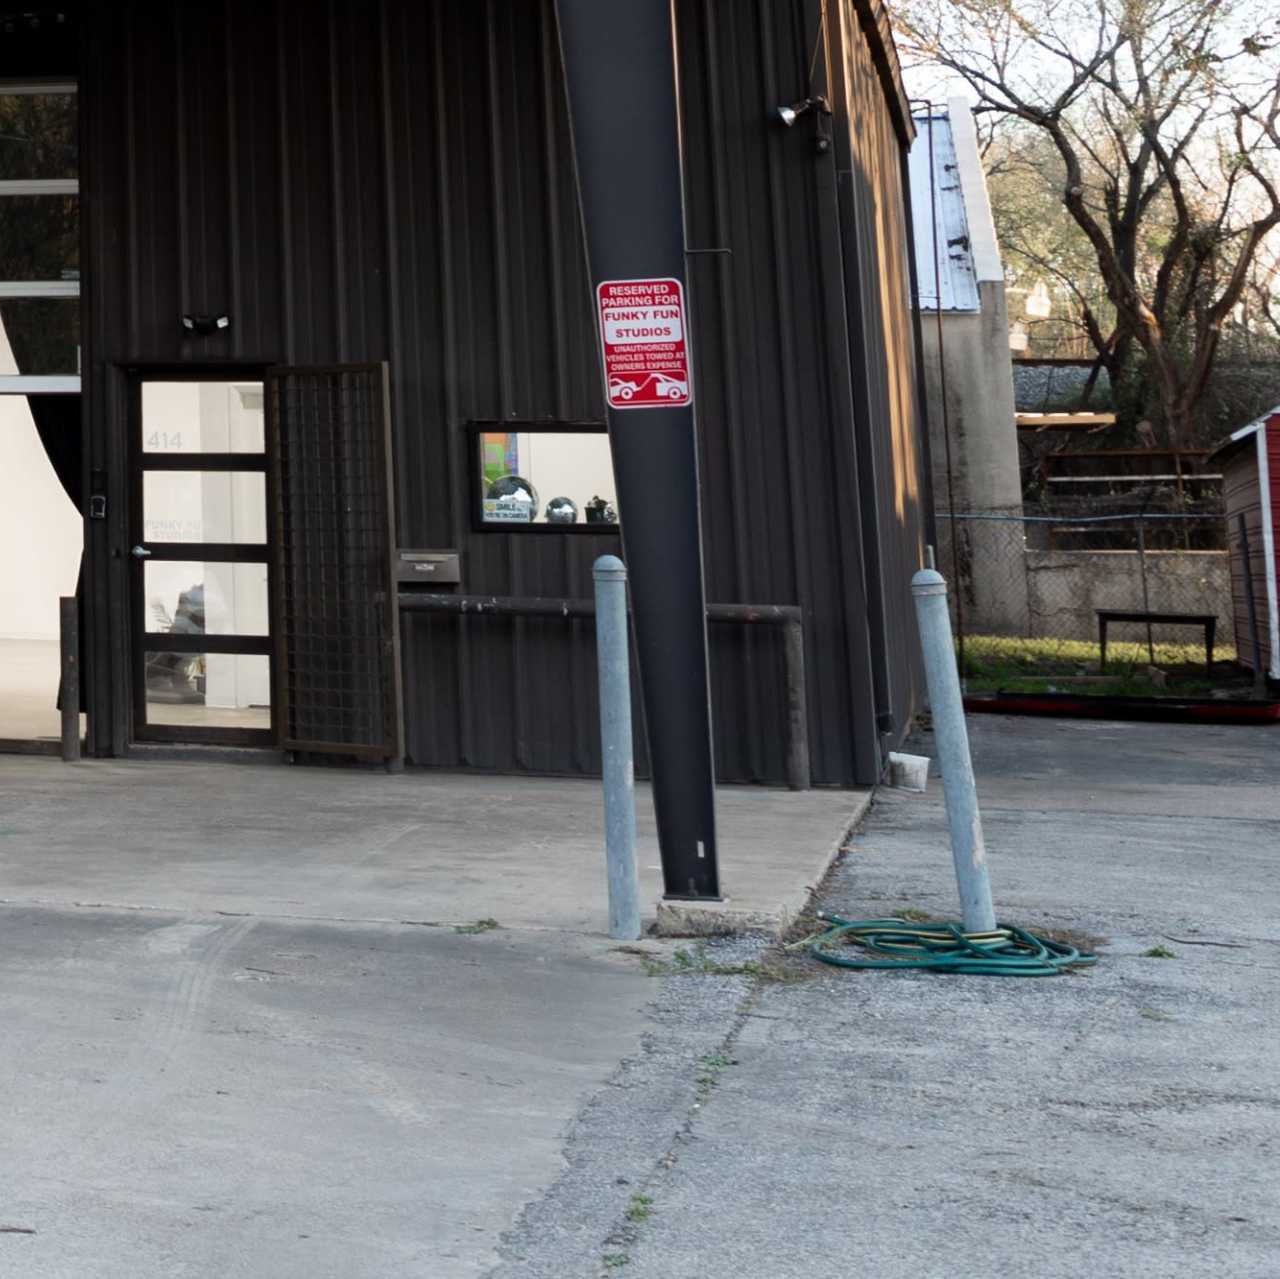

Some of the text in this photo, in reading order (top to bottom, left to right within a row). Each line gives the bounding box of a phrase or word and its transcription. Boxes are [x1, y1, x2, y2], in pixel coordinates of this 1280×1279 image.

[609, 285, 669, 295] RESERVED
[602, 295, 679, 307] PARKING FOR
[605, 309, 679, 321] FUNKY FUN
[615, 327, 671, 338] STUDIOS
[614, 344, 676, 352] UNAUTHORIZED
[606, 351, 684, 362] VEHICLES TOWED AT
[611, 361, 681, 371] OWNERS EXPENSE
[147, 432, 183, 449] 414
